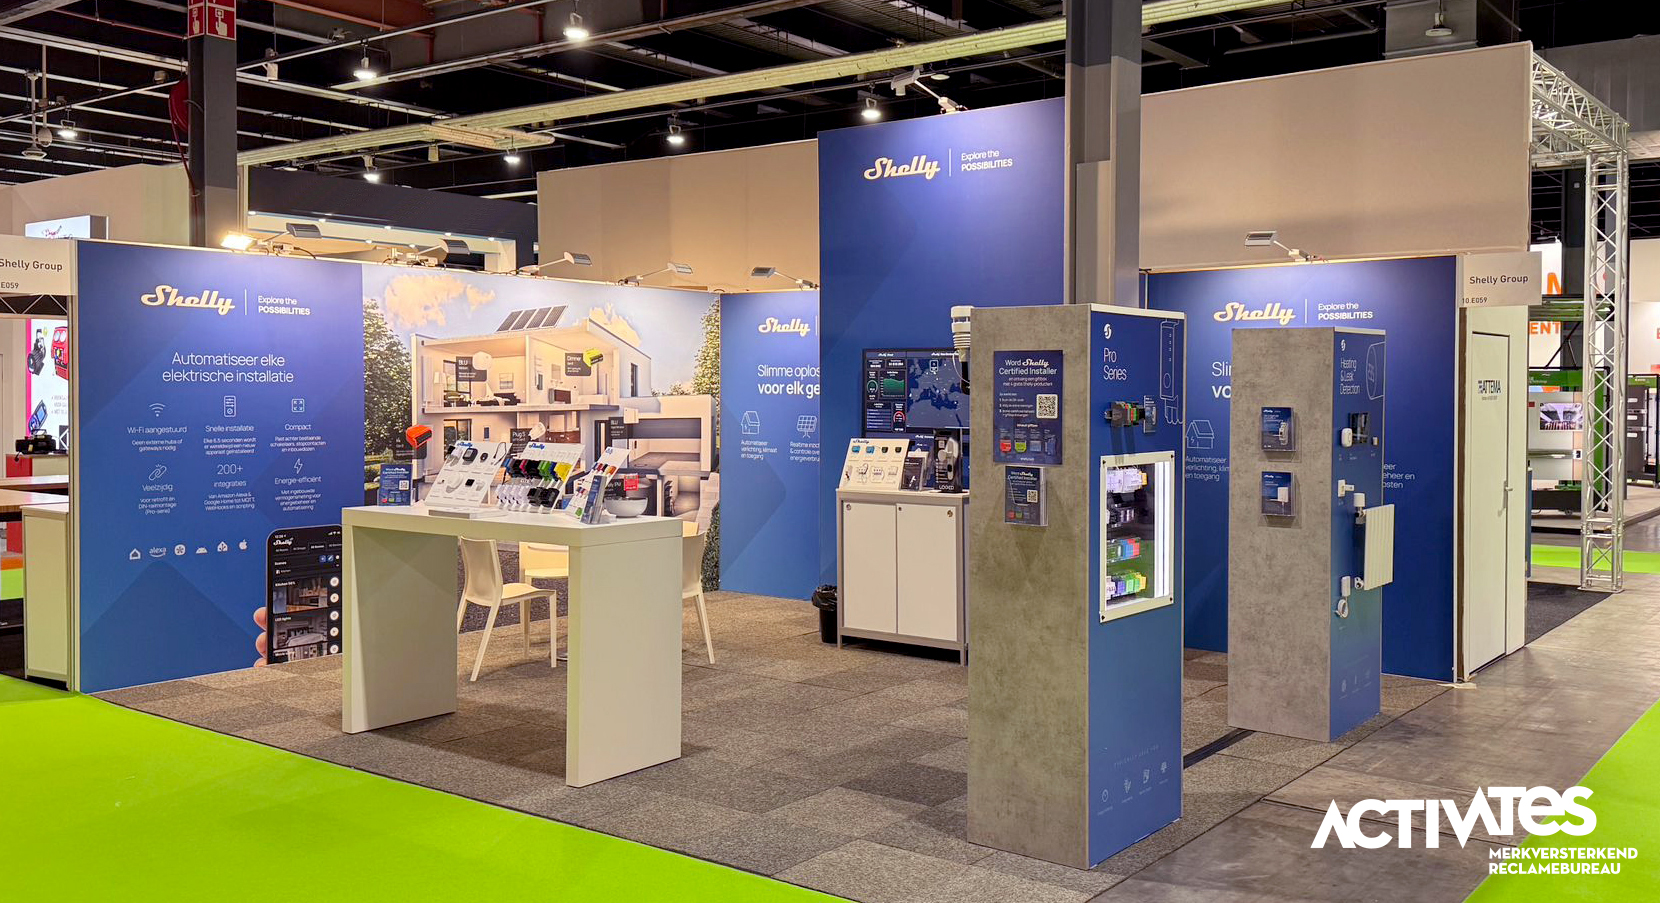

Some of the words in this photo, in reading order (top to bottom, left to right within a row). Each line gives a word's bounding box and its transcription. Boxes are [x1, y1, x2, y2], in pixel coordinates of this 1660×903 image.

[961, 151, 986, 162] Explore
[987, 150, 1000, 159] the
[863, 154, 940, 180] Shelly
[961, 158, 1013, 172] POSSIBILITIES
[0, 259, 30, 271] Shelly
[33, 260, 63, 272] Group
[1469, 275, 1498, 285] Shelly
[1500, 274, 1529, 284] Group
[140, 284, 235, 316] Shelly
[258, 295, 284, 305] Explore
[285, 296, 297, 305] the
[1462, 296, 1488, 304] 10.E059
[258, 305, 311, 316] POSSIBILITIES
[1318, 303, 1345, 312] Explore
[1346, 302, 1359, 310] the
[1213, 302, 1296, 326] Shelly
[1318, 311, 1373, 321] POSSIBILITIES
[758, 316, 811, 337] Shelly
[172, 351, 258, 367] Automatiseer
[260, 354, 285, 367] elke
[1103, 347, 1117, 363] Pro
[1022, 358, 1050, 368] Shelly
[1341, 357, 1357, 372] Heating
[162, 368, 234, 383] elektrische
[236, 370, 294, 383] installatie
[757, 364, 793, 378] Slimme
[999, 367, 1029, 375] Certified
[1030, 367, 1058, 375] Installer
[1103, 364, 1127, 381] Series
[758, 382, 784, 395] voor
[786, 381, 804, 395] elk
[1340, 383, 1360, 395] Detection
[127, 426, 144, 435] Wi-Fi
[145, 426, 188, 435] aangestuurd
[284, 423, 312, 431] Compact
[217, 463, 243, 475] 200+
[1194, 472, 1220, 481] toegang
[142, 484, 173, 492] Veelzijdig
[214, 480, 247, 489] integraties
[149, 547, 167, 555] alexa
